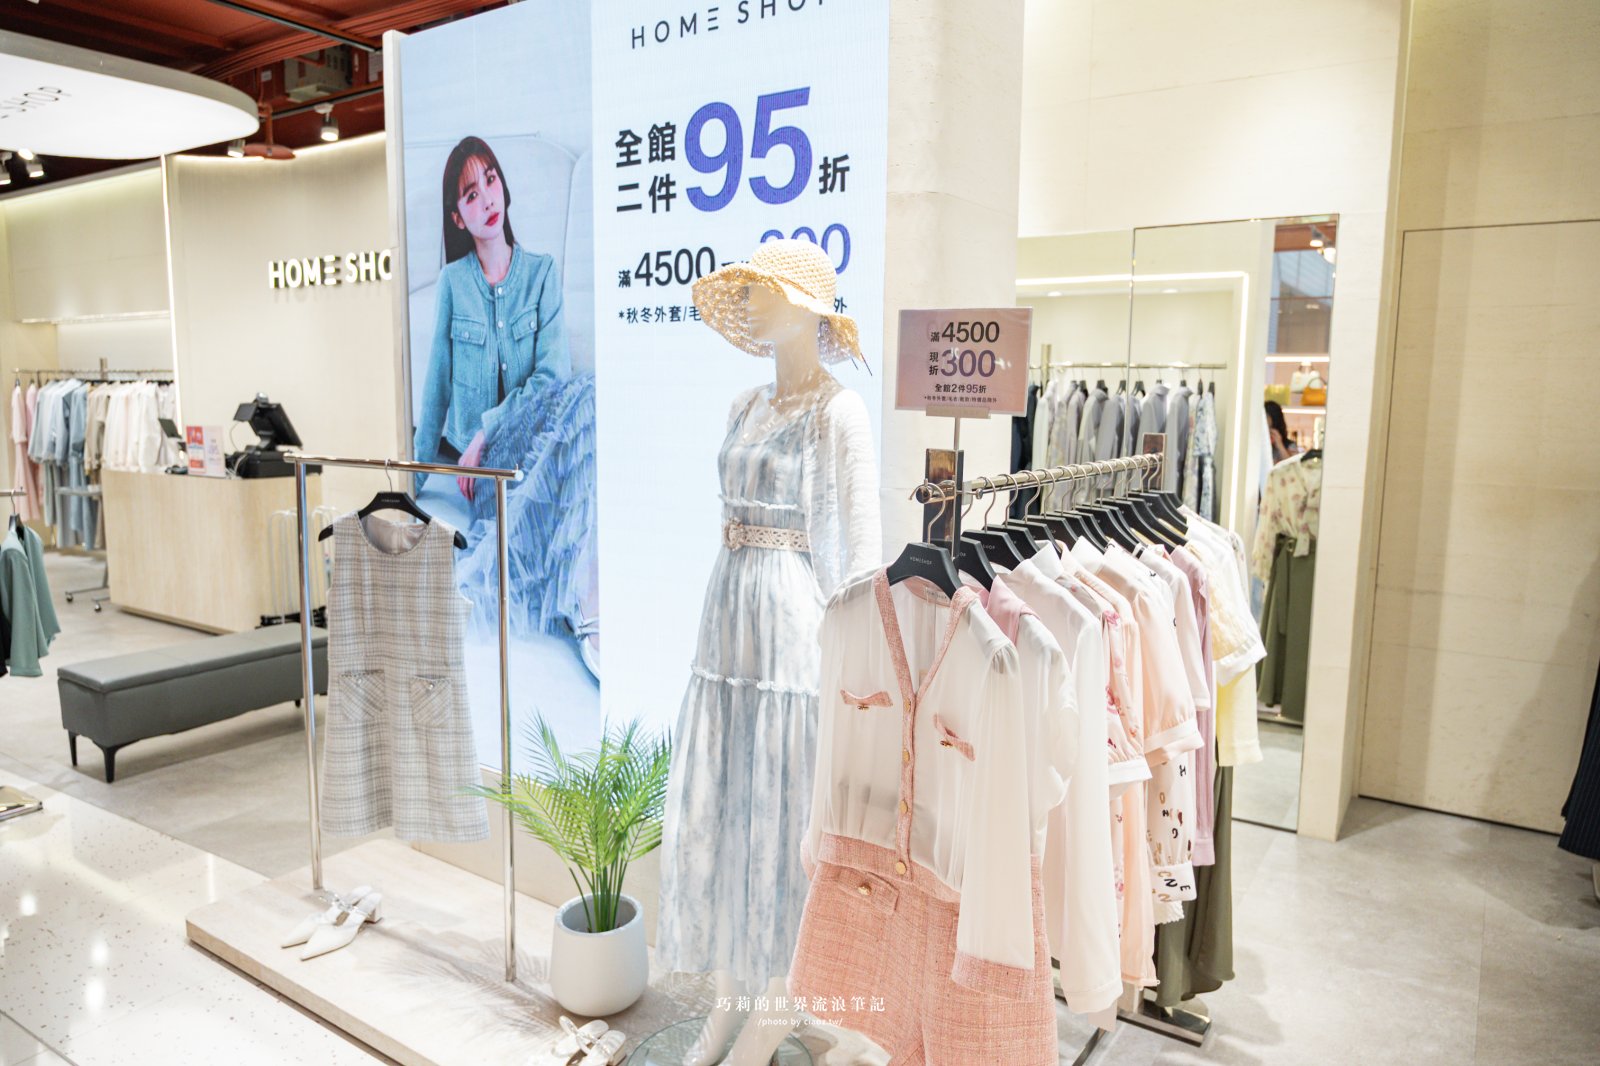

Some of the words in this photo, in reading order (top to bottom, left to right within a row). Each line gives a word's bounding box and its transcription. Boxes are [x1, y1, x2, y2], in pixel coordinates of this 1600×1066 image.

[631, 7, 719, 49] HOME
[615, 121, 677, 168] 全館
[616, 173, 677, 214] 二件
[268, 254, 338, 289] HOME
[935, 383, 987, 394] 全館2件95折
